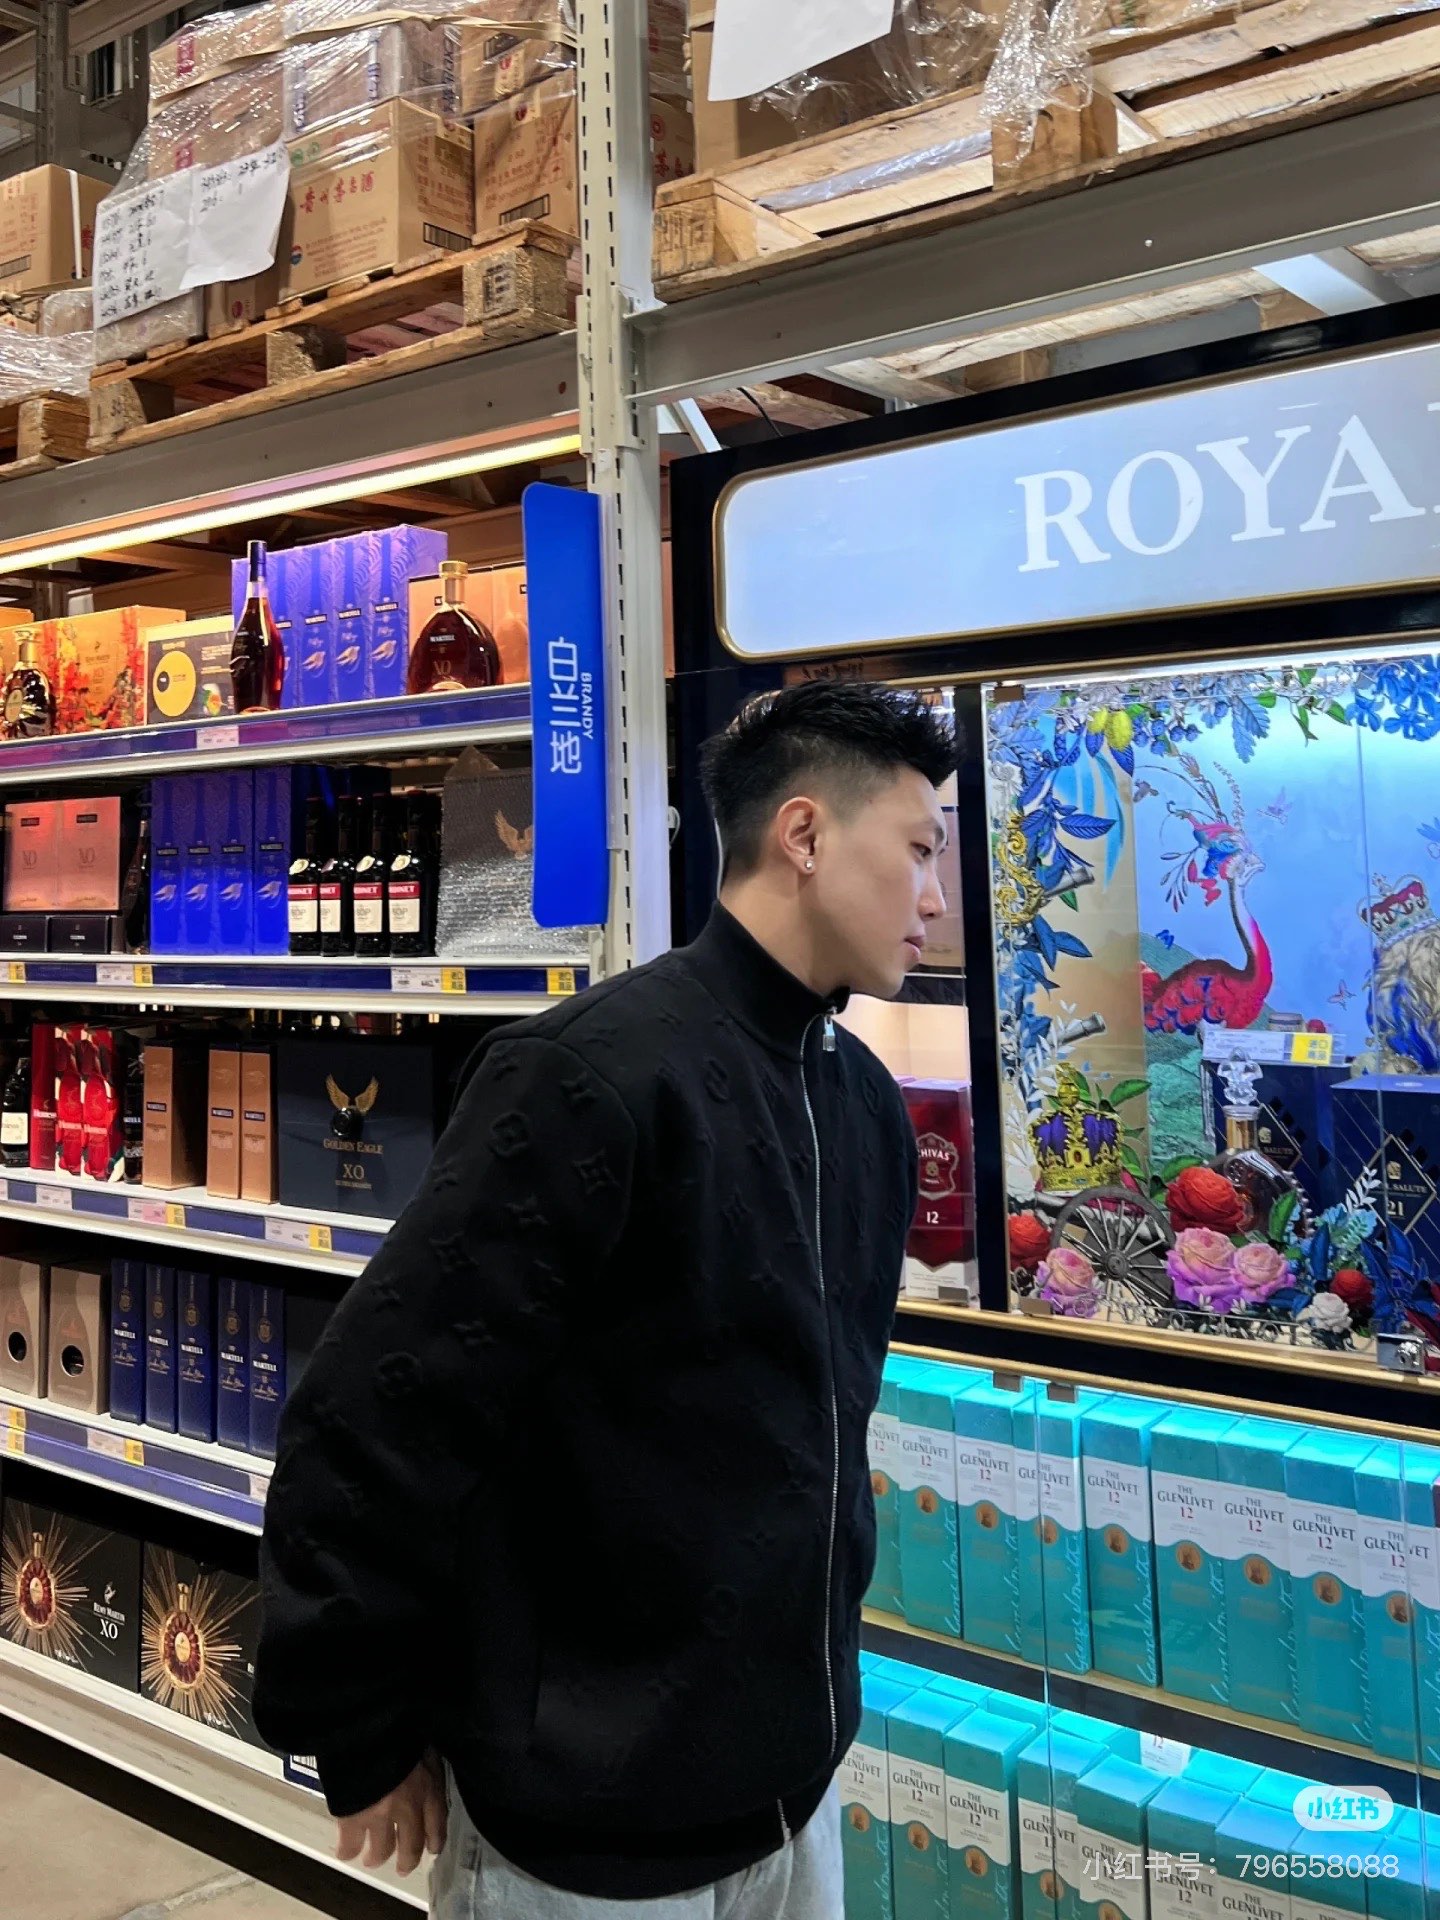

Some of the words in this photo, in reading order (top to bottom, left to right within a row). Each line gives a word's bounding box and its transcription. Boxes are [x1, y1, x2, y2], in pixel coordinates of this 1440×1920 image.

[1013, 402, 1440, 573] ROYA
[547, 636, 582, 774] 白兰地
[581, 671, 594, 741] BRANDY
[918, 1148, 950, 1162] HIVAS
[342, 1163, 366, 1180] XO
[926, 1211, 939, 1225] 12
[902, 1440, 949, 1459] GLENLIVET
[921, 1456, 932, 1467] 12
[960, 1454, 1009, 1473] GLENLIVET
[979, 1469, 991, 1481] 12
[1087, 1475, 1139, 1496] GLENLIVET
[1108, 1491, 1120, 1504] 12
[1157, 1490, 1214, 1511] GLENLIVET
[1180, 1506, 1194, 1519] 12
[1224, 1502, 1285, 1523] GLENLIVET
[1248, 1519, 1262, 1533] 12
[1292, 1518, 1356, 1542] GLENLIVET
[1317, 1536, 1333, 1550] 12
[1364, 1536, 1430, 1560] GLENLVET
[1391, 1554, 1406, 1568] 12
[100, 1618, 118, 1639] XO
[853, 1771, 864, 1784] 12
[893, 1772, 941, 1796] GLENLIVET
[911, 1789, 923, 1803] 12
[950, 1795, 1000, 1821] GLENLIVET
[969, 1813, 982, 1827] 12
[1178, 1889, 1192, 1904] 12
